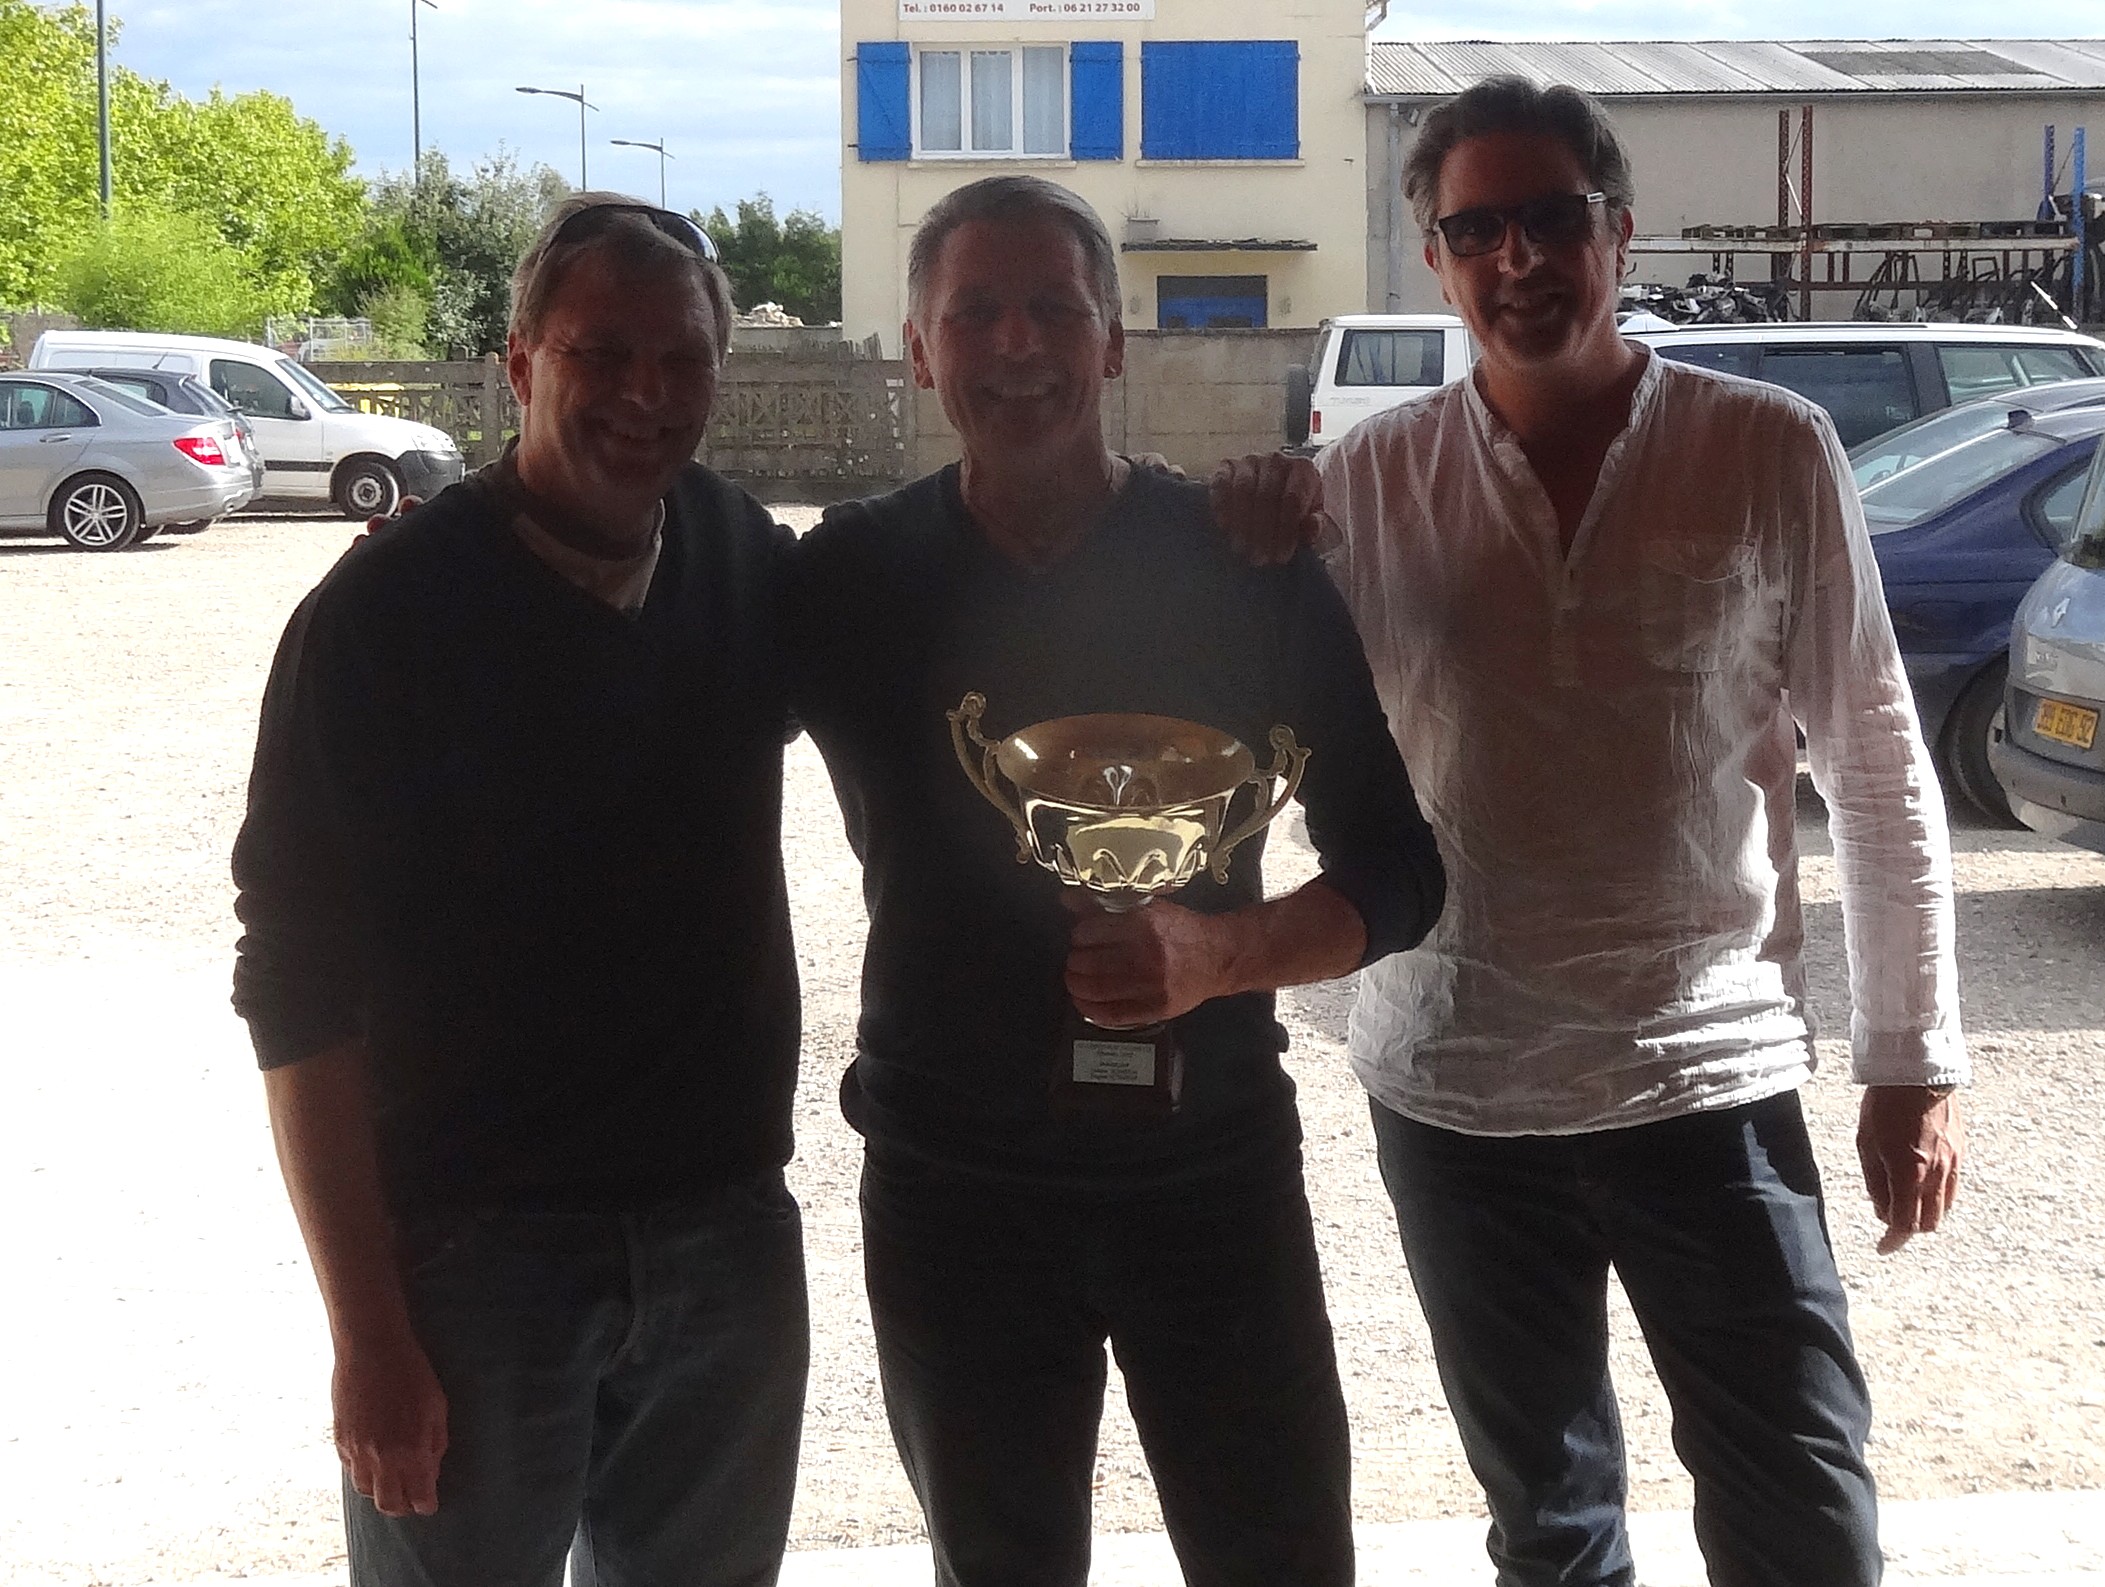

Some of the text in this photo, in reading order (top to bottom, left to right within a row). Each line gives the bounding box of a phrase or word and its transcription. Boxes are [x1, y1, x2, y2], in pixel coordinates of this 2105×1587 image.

[958, 3, 972, 13] 02
[990, 3, 1004, 13] 14
[1063, 3, 1078, 13] 06
[1079, 3, 1092, 13] 21
[1095, 3, 1108, 13] 27
[1111, 3, 1124, 12] 32
[1126, 3, 1141, 12] 00
